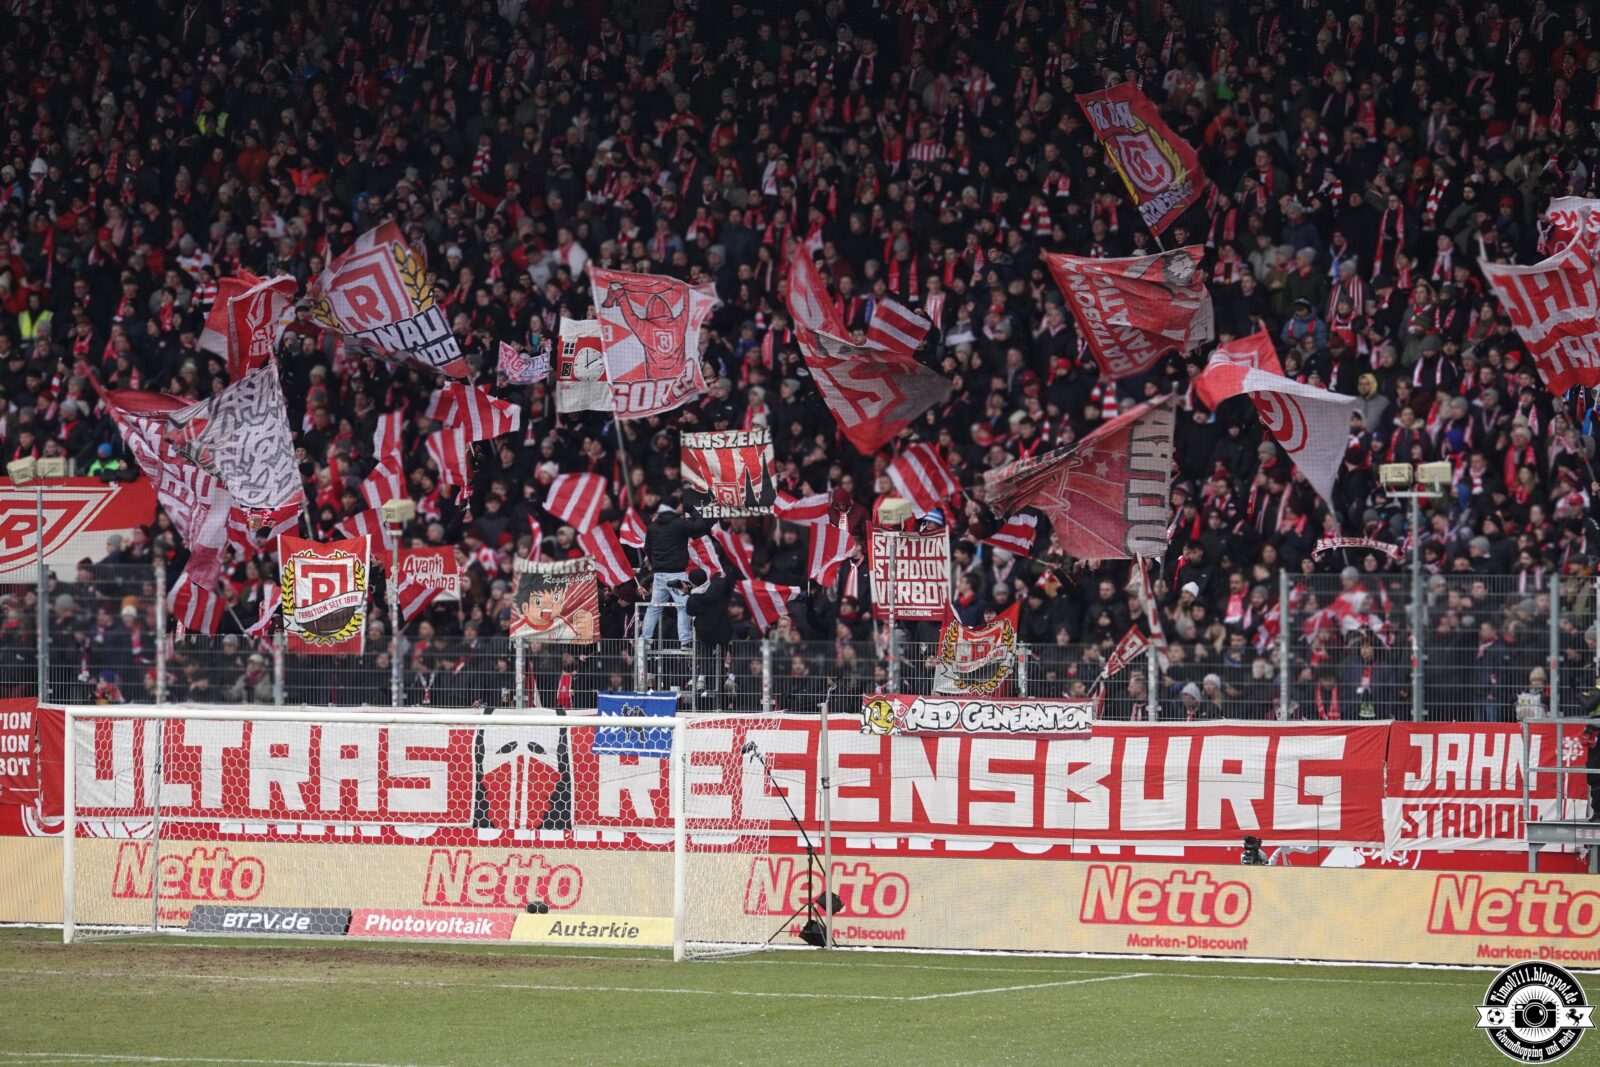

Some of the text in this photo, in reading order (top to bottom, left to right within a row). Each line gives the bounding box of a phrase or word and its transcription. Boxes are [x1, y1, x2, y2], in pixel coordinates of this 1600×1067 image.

[680, 428, 773, 450] FANSZENE
[403, 554, 444, 575] Avanti
[297, 604, 328, 619] TRADITION
[328, 598, 343, 609] SEIT
[904, 698, 1093, 732] RED GENERATION
[1404, 732, 1542, 791] JAHN
[75, 718, 1347, 831] ULTRAS REGENSBURG
[112, 841, 265, 900] Netto
[422, 849, 583, 909] Netto
[743, 856, 910, 918] Netto
[1079, 864, 1252, 928] Netto
[1427, 873, 1600, 938] Netto
[223, 912, 311, 930] BTPV.de
[364, 913, 494, 936] Photovoltaik
[548, 920, 640, 939] Autarkie
[789, 924, 905, 940] Mn-Discount
[1126, 933, 1249, 950] Marken-Discount
[1476, 943, 1600, 961] Marken-Discount
